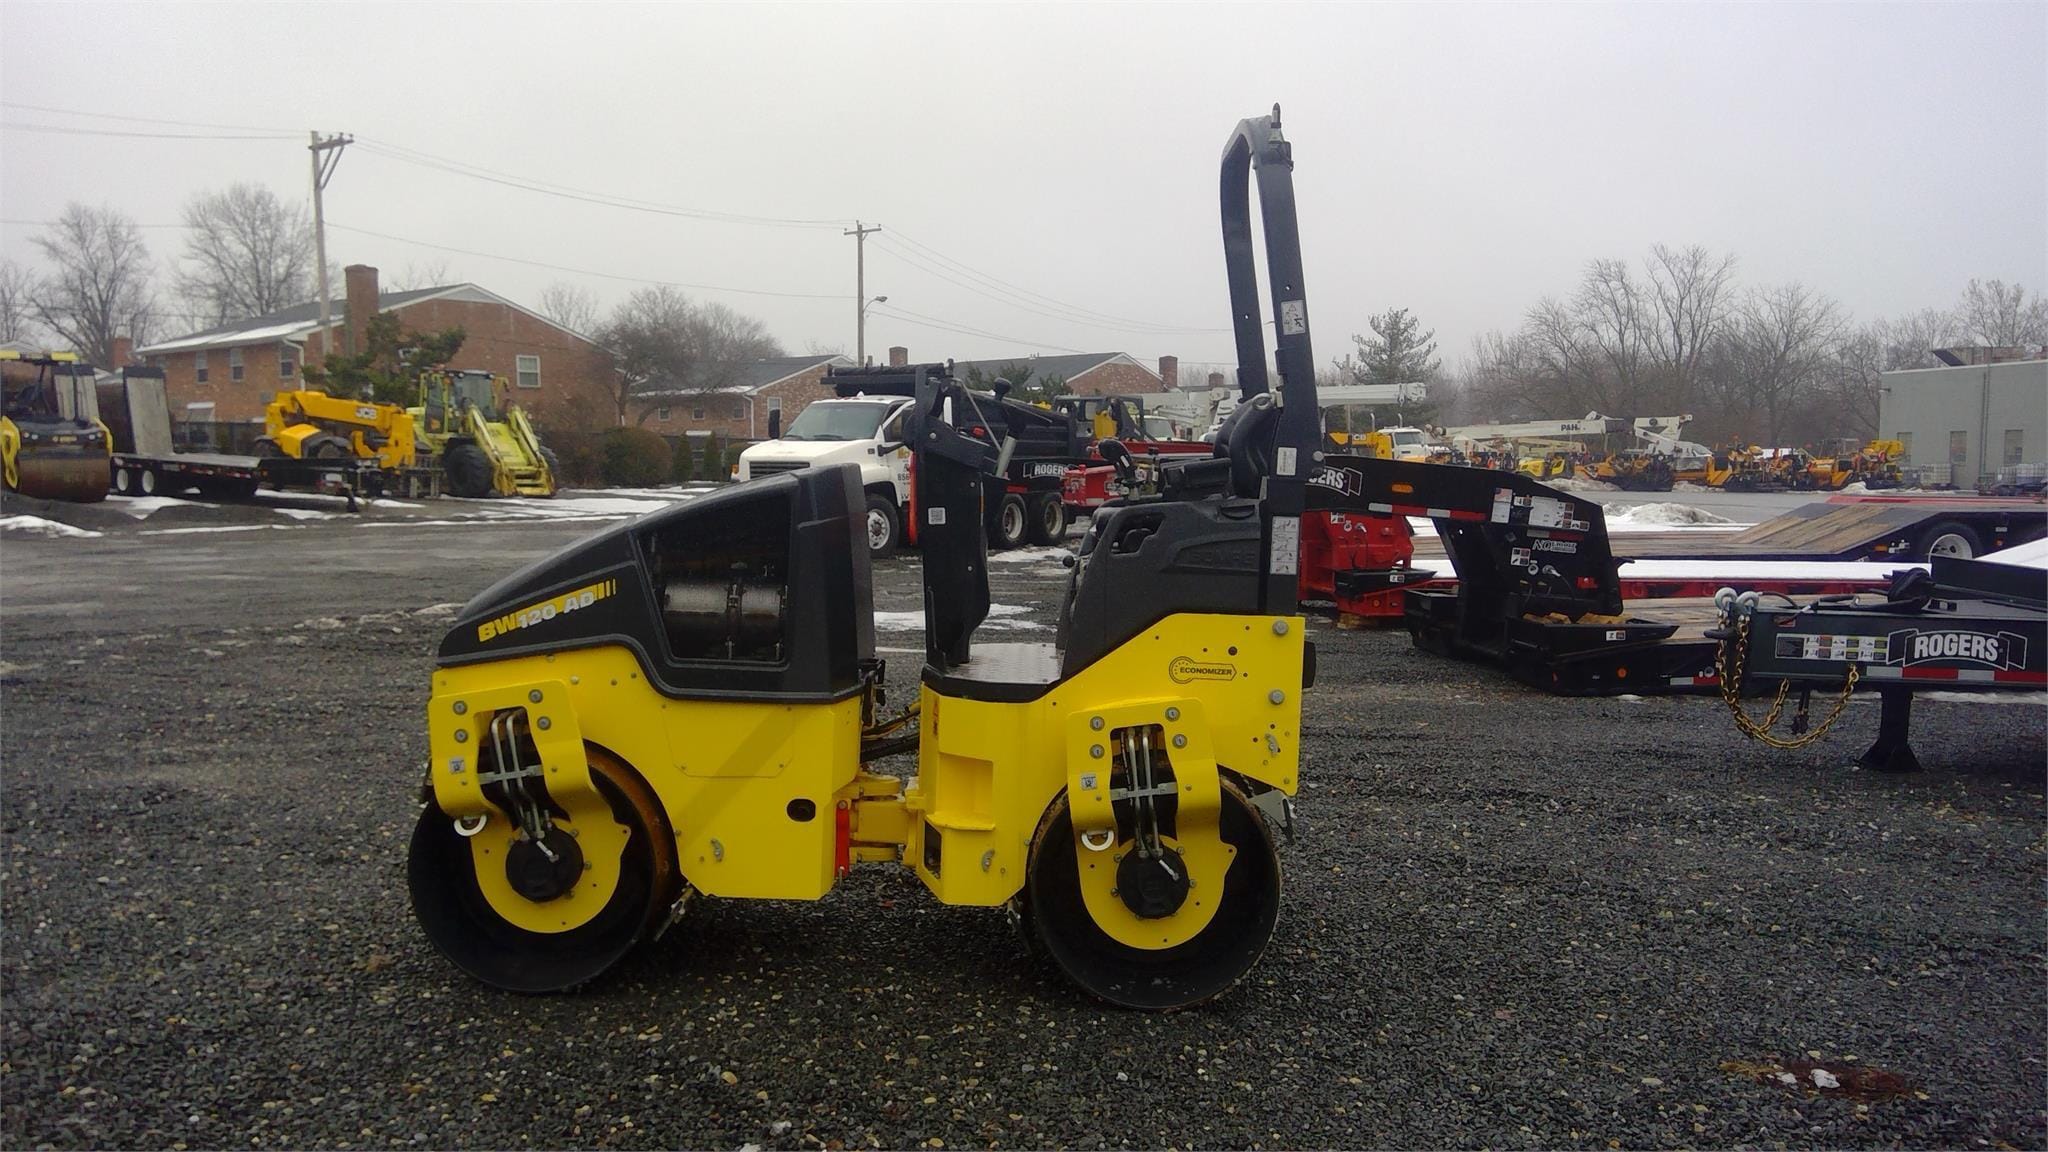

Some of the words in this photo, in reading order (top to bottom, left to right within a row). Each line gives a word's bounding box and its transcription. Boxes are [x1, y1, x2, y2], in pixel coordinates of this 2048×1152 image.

[355, 407, 377, 420] JCB
[563, 591, 595, 614] AD
[1914, 633, 1999, 661] ROGERS
[1180, 666, 1232, 676] ECONOMIZER
